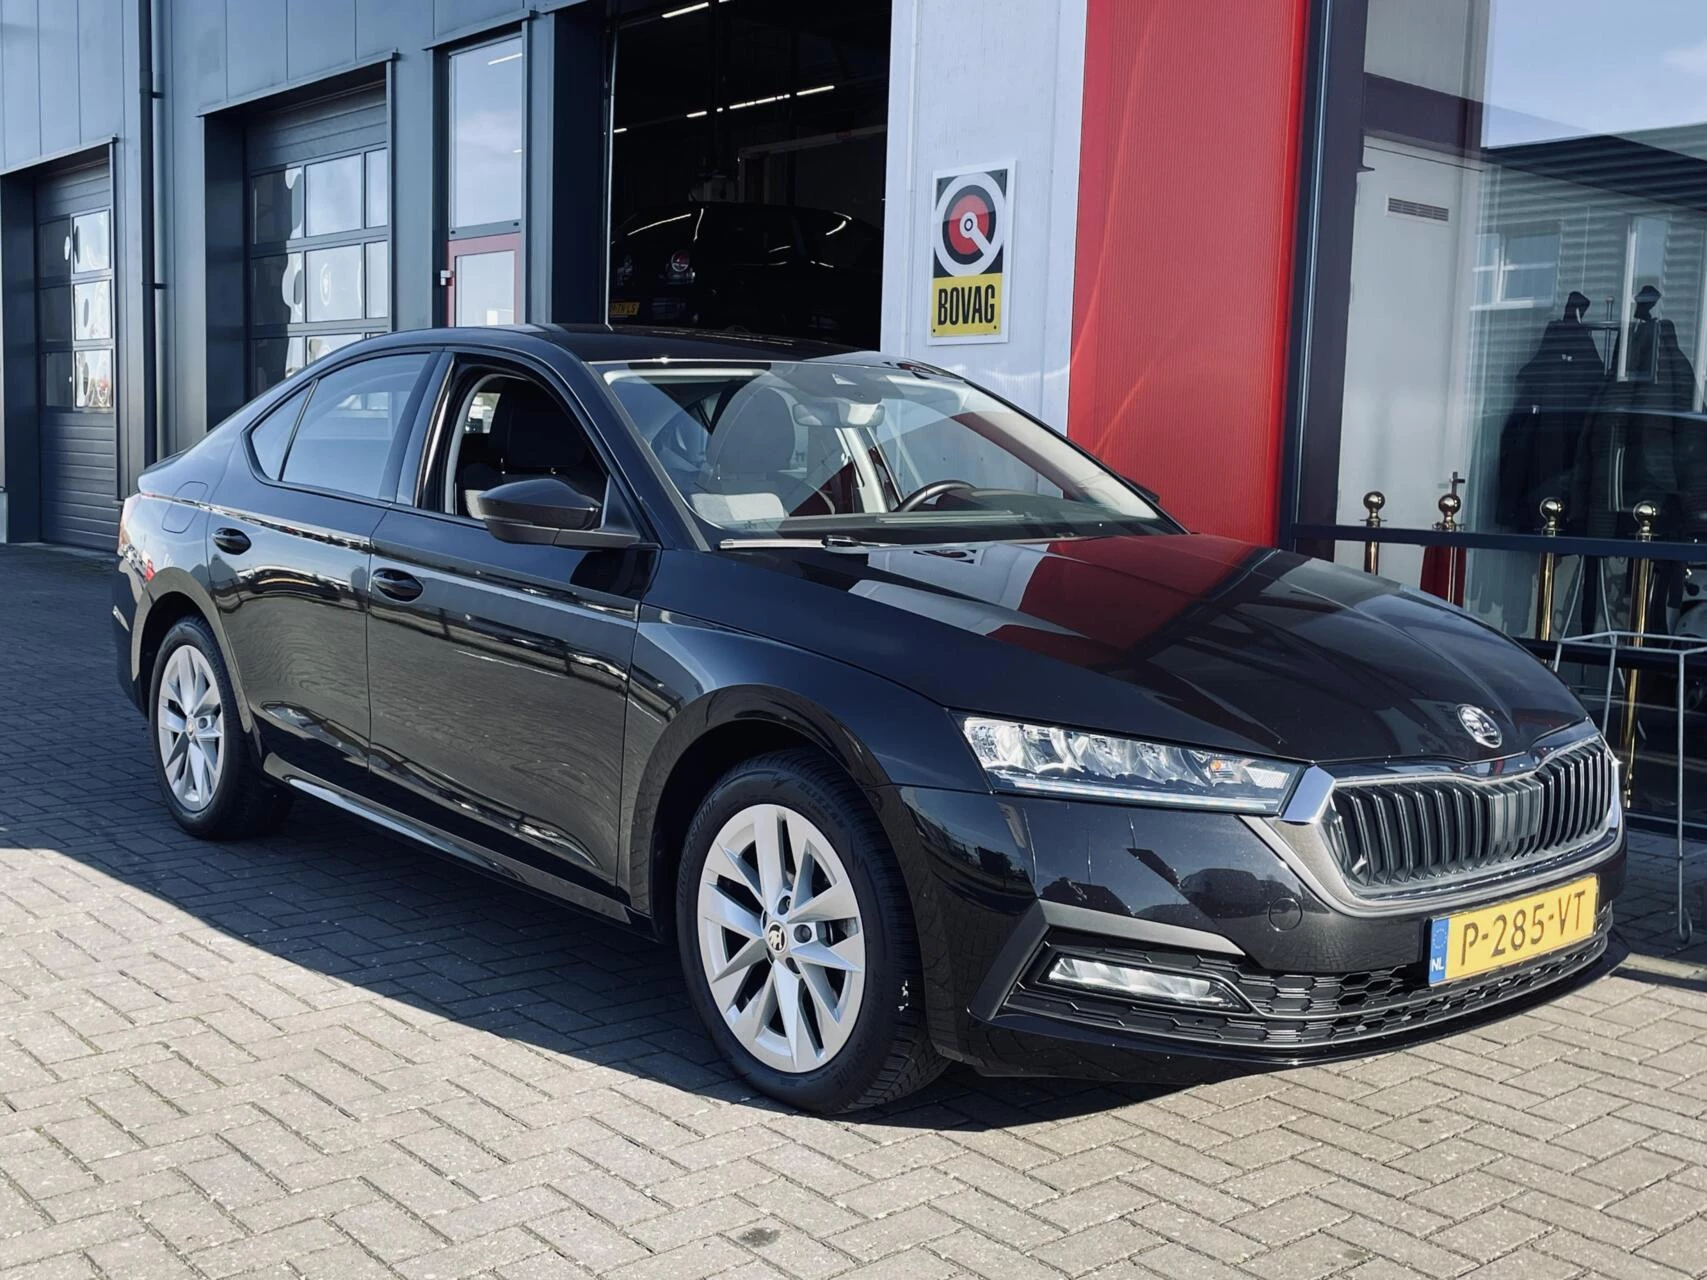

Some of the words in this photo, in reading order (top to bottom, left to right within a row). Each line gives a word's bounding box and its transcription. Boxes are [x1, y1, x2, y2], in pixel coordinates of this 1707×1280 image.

[938, 284, 995, 325] BOVAG
[1461, 890, 1586, 966] P-285-VT
[1430, 957, 1445, 973] NL
